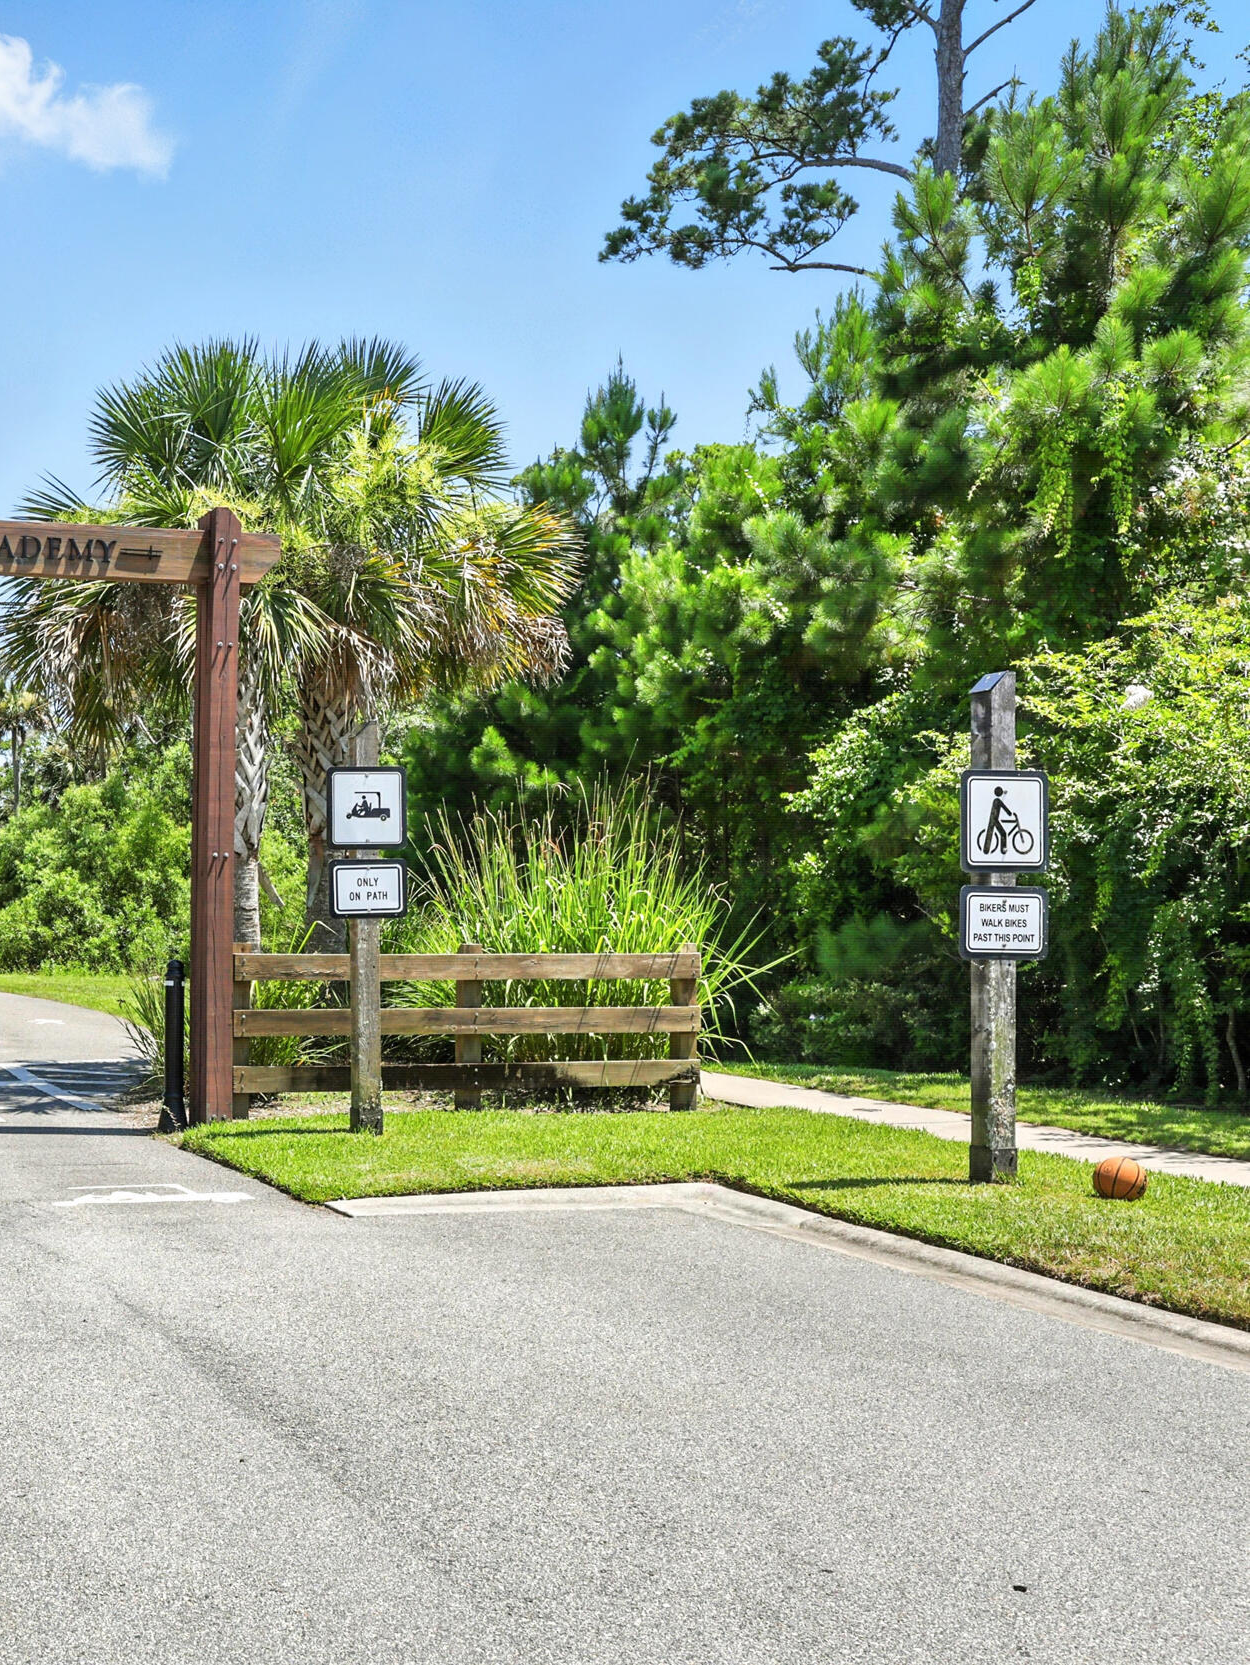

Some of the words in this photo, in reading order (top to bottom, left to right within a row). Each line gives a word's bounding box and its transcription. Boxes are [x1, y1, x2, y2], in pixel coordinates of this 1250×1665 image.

[356, 877, 379, 887] ONLY
[349, 891, 361, 901] ON
[366, 891, 388, 901] PATH
[979, 903, 1007, 912] BIKERS
[1008, 904, 1030, 913] MUST
[981, 918, 1003, 927] WALK
[1004, 919, 1027, 928] BIKES
[973, 933, 992, 942] PAST
[993, 933, 1011, 942] THIS
[1012, 934, 1035, 943] POINT
